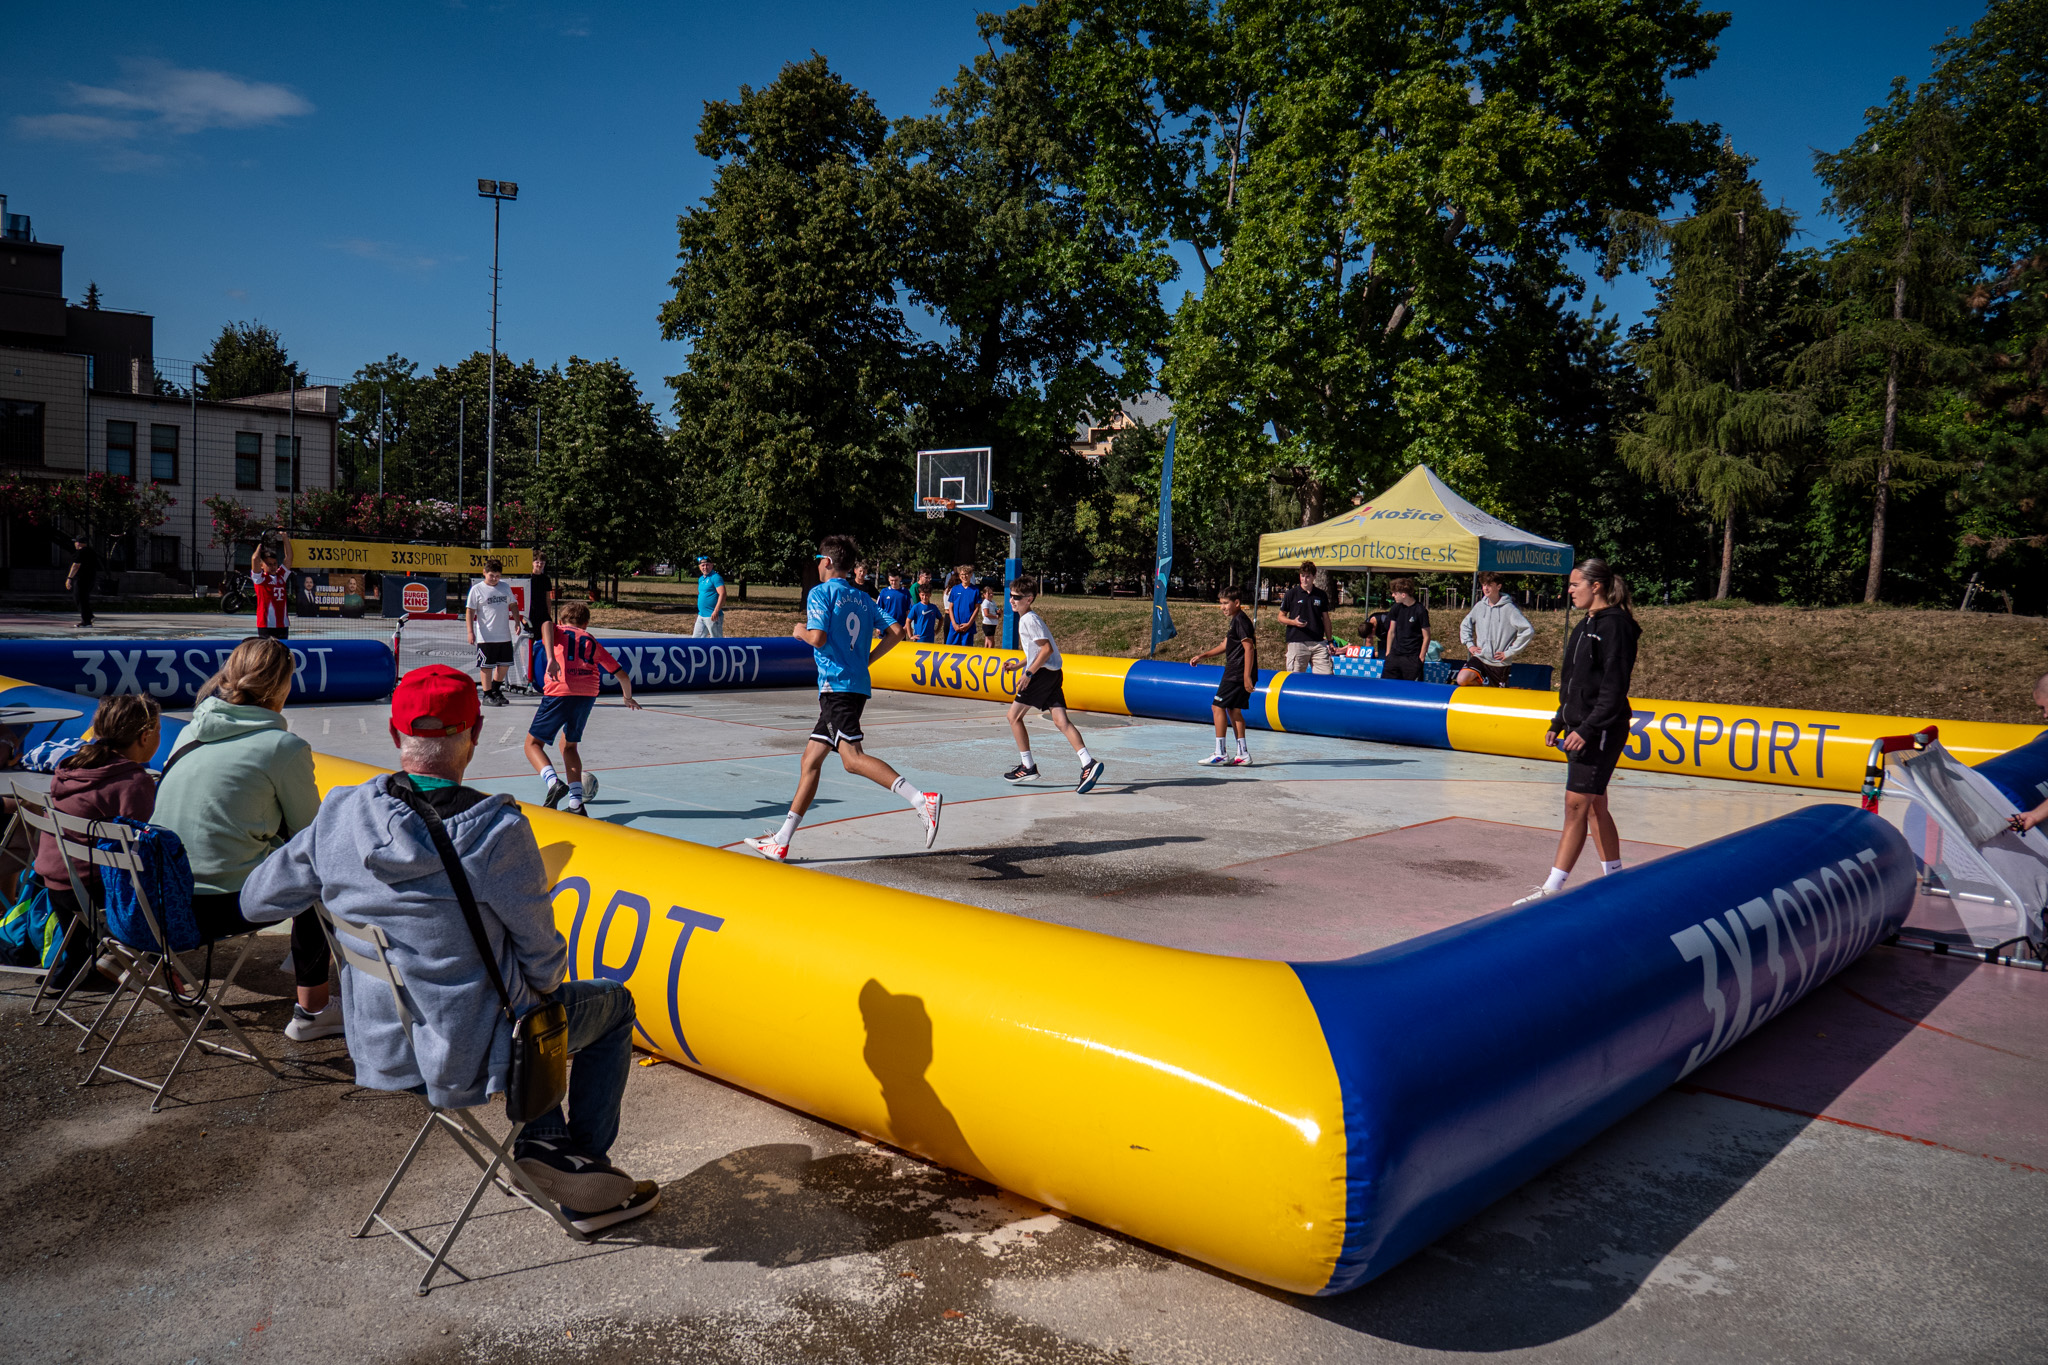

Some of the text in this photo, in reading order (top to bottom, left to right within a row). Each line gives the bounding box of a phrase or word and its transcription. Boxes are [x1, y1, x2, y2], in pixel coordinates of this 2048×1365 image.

[1370, 508, 1443, 521] Košice
[308, 547, 369, 562] 3X3SPORT
[391, 551, 448, 566] 3X3SPORT
[1278, 541, 1458, 563] www.sportkosice.sk
[1496, 546, 1562, 566] www.kosice.sk
[404, 598, 428, 606] KING
[846, 611, 861, 651] 9
[563, 629, 596, 665] 10
[911, 650, 1027, 695] 3X3SPO
[1556, 709, 1840, 778] 3SPORT
